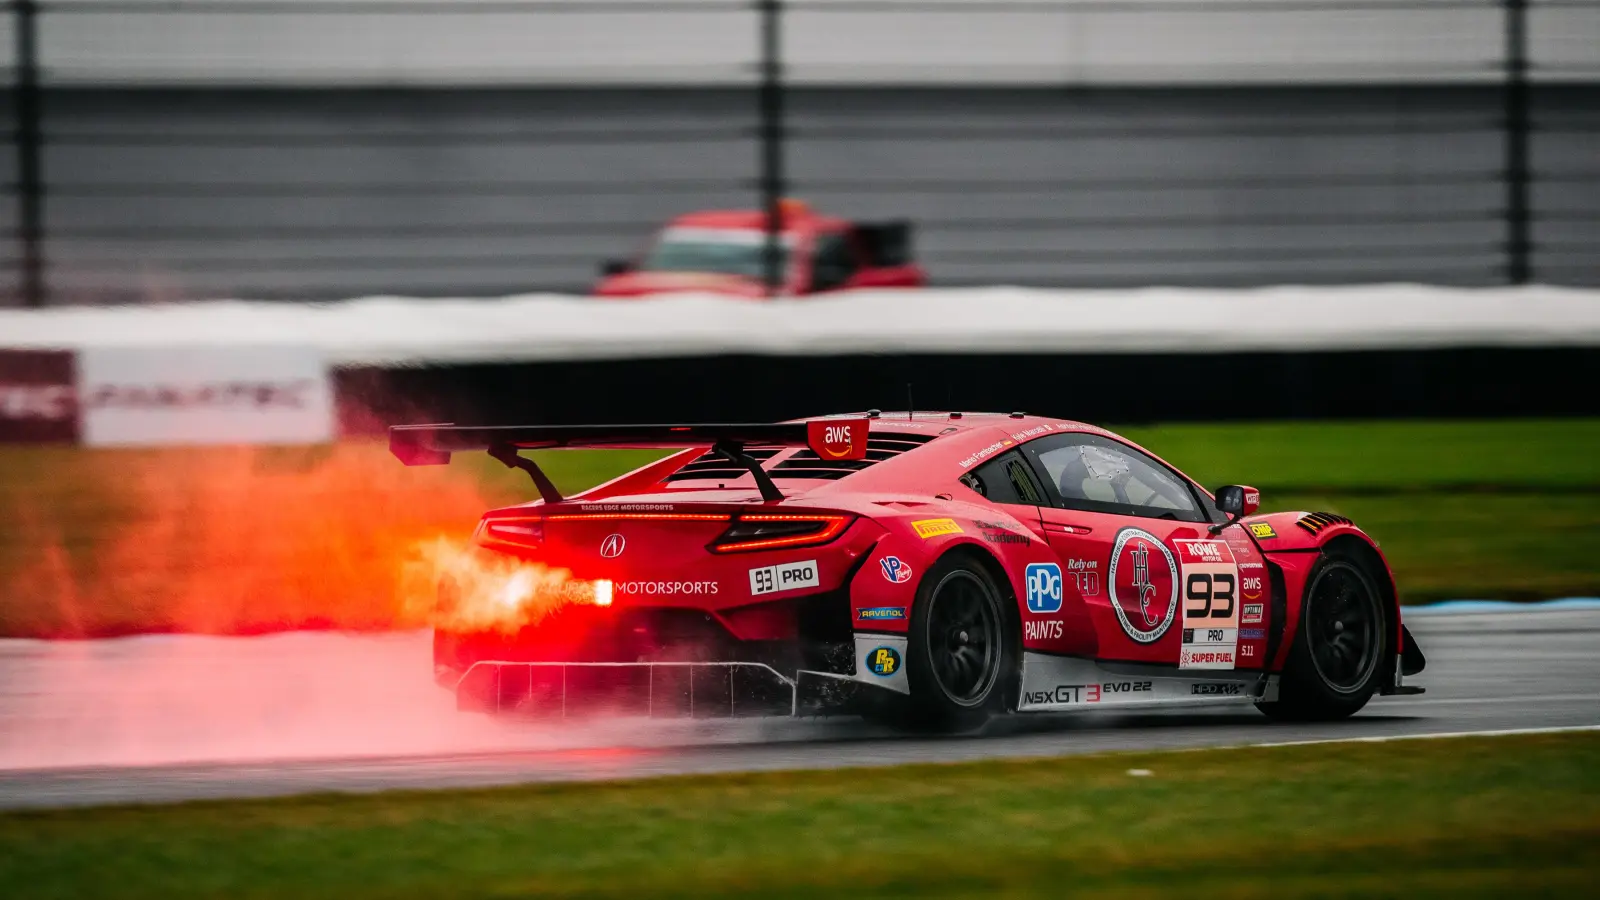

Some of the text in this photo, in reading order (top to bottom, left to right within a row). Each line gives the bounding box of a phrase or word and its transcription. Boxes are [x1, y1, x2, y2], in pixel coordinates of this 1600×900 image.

[825, 426, 851, 443] aws
[1251, 525, 1272, 536] OMP
[1185, 542, 1221, 556] ROWE
[880, 556, 901, 583] VP
[1068, 558, 1098, 571] Rely on
[755, 567, 813, 592] 93 PRO
[1243, 577, 1261, 590] aws
[615, 581, 719, 594] MOTORSPORTS
[1028, 568, 1060, 607] PPG
[1186, 573, 1235, 619] 93
[861, 609, 903, 617] RAVENOL
[1025, 620, 1064, 640] PAINTS
[1133, 631, 1153, 641] FACILITY
[1207, 629, 1224, 642] PRO
[1191, 652, 1233, 663] SUPER FUEL
[1024, 681, 1153, 704] NSX GT3 EVO 22
